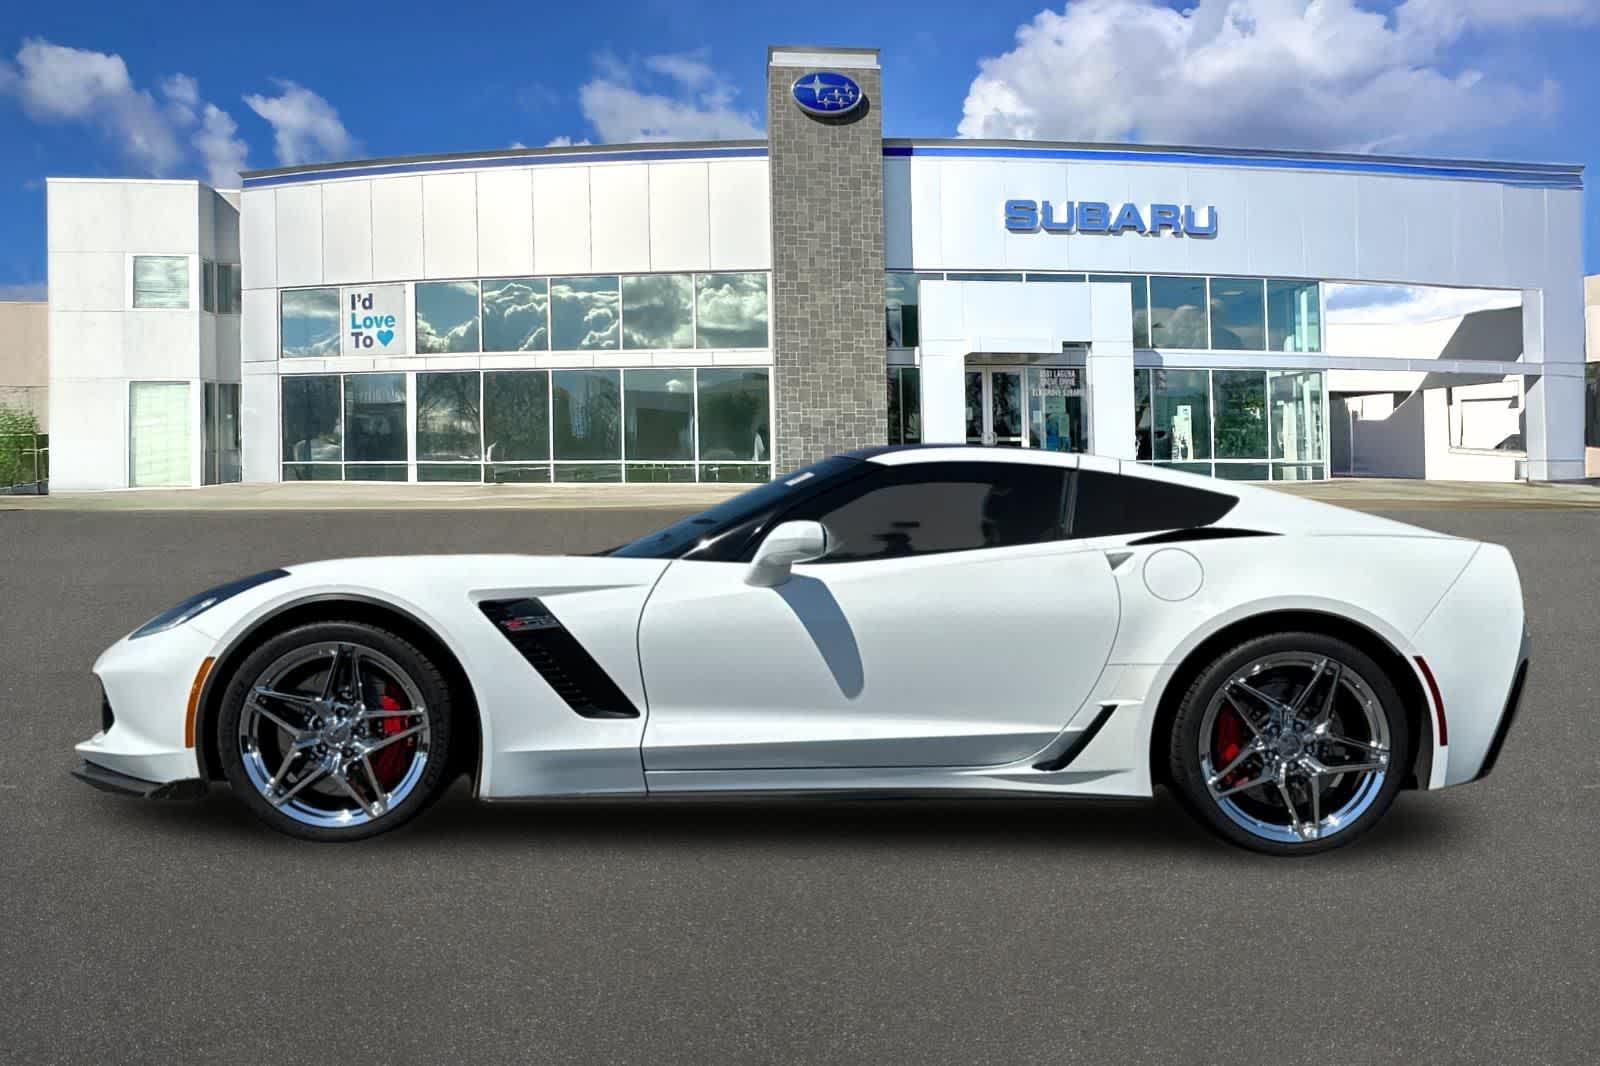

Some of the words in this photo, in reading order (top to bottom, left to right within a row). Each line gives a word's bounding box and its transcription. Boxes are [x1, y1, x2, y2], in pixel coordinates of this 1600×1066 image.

[1004, 199, 1218, 239] SUBARU
[351, 293, 374, 311] I'd
[351, 312, 396, 330] Love
[351, 331, 374, 349] To
